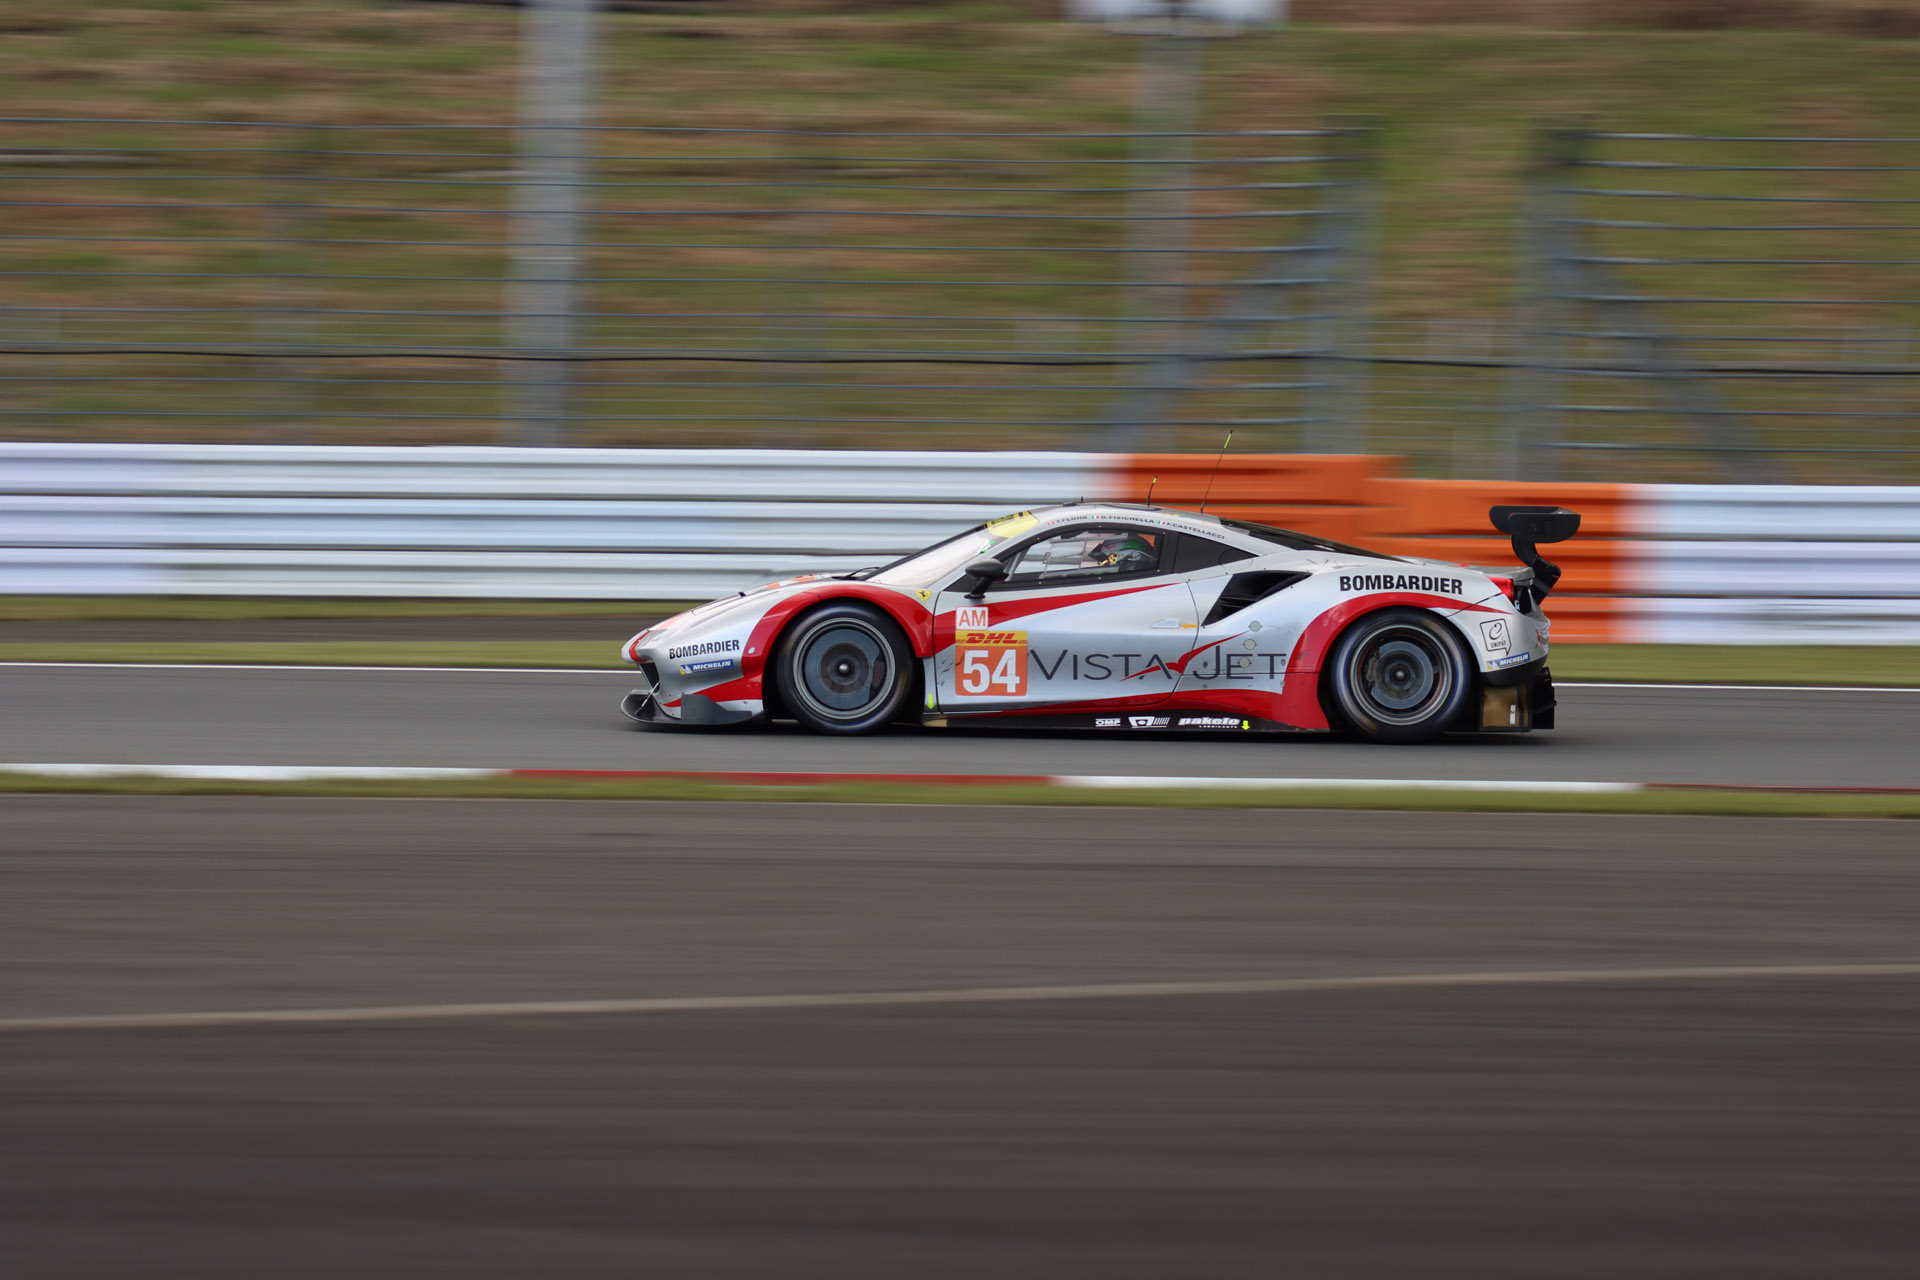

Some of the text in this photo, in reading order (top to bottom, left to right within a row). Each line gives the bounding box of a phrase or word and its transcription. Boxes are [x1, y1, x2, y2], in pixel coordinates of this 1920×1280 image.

[1166, 521, 1225, 540] F.CASTELLACCI
[1339, 574, 1463, 595] BOMBARDIER
[958, 609, 986, 627] AM
[965, 632, 1018, 644] DHL
[669, 639, 740, 660] BOMBARDIER
[692, 660, 731, 671] MICHELIN
[1499, 653, 1529, 666] MICHELIN
[962, 649, 1020, 693] 54
[1177, 716, 1241, 726] pakelo
